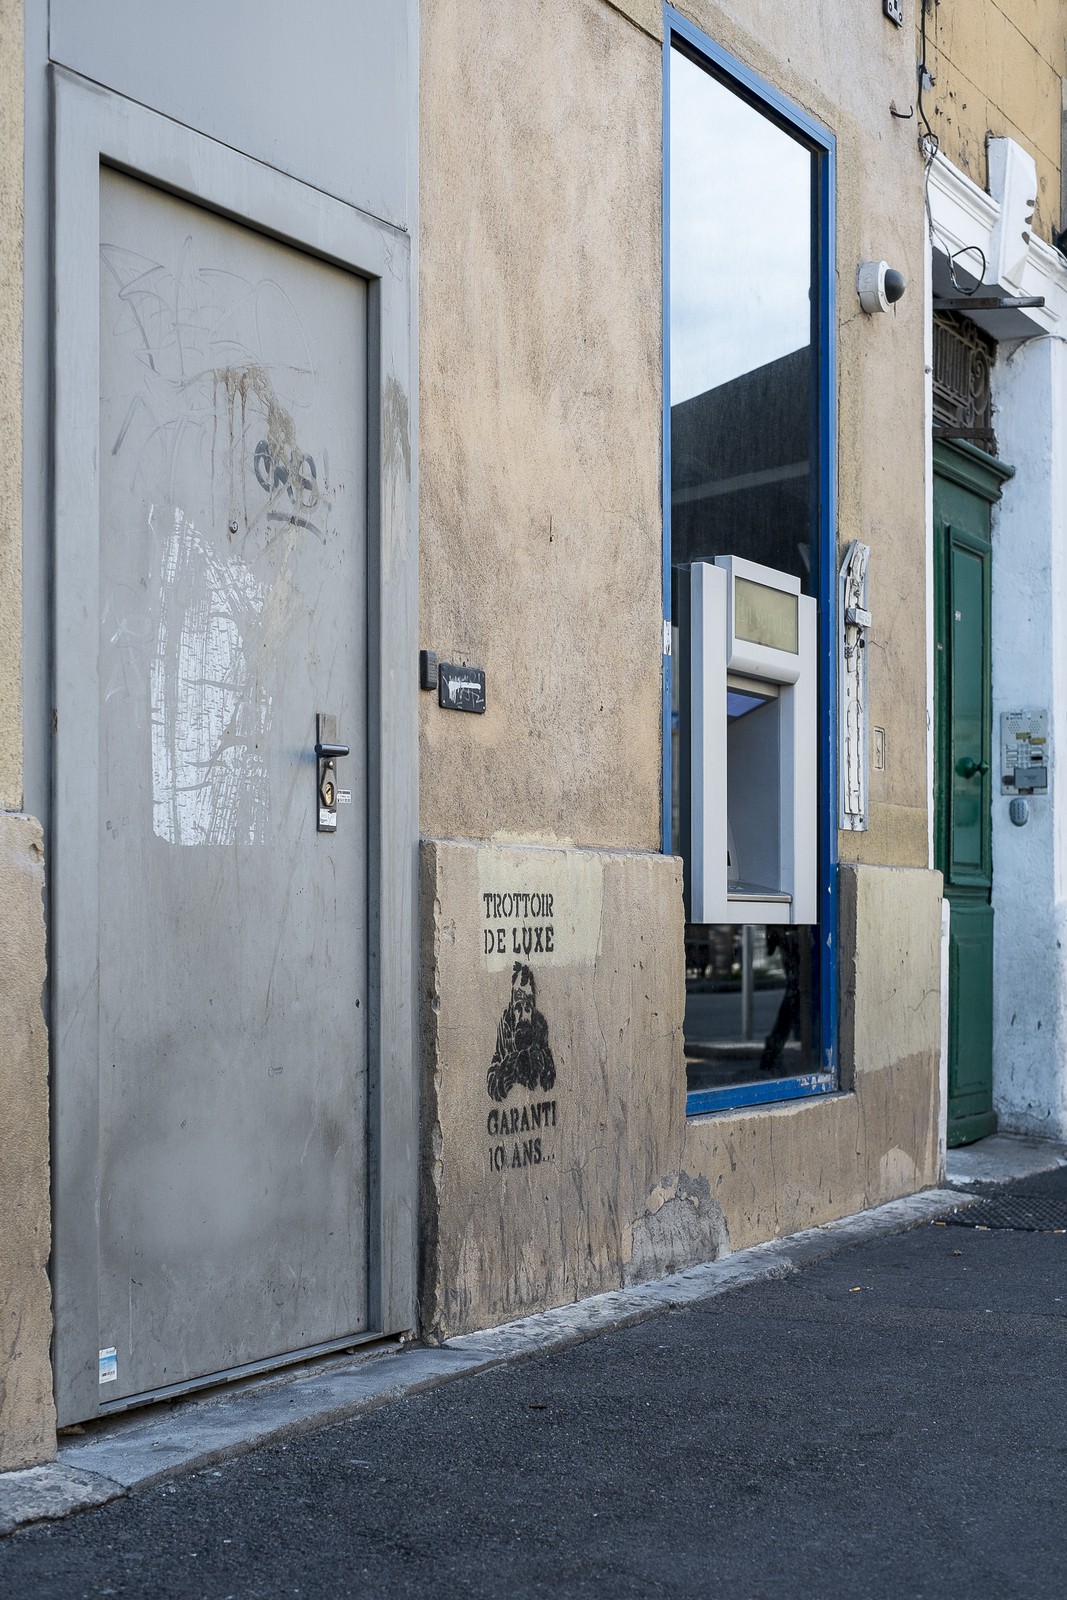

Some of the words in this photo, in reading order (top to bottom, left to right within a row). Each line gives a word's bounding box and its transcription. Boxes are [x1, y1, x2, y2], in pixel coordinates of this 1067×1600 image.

[483, 893, 554, 918] TROTTOIR
[484, 928, 506, 954] DE
[512, 926, 555, 954] LUXE
[487, 1100, 556, 1135] GARANTI
[488, 1144, 504, 1172] 10
